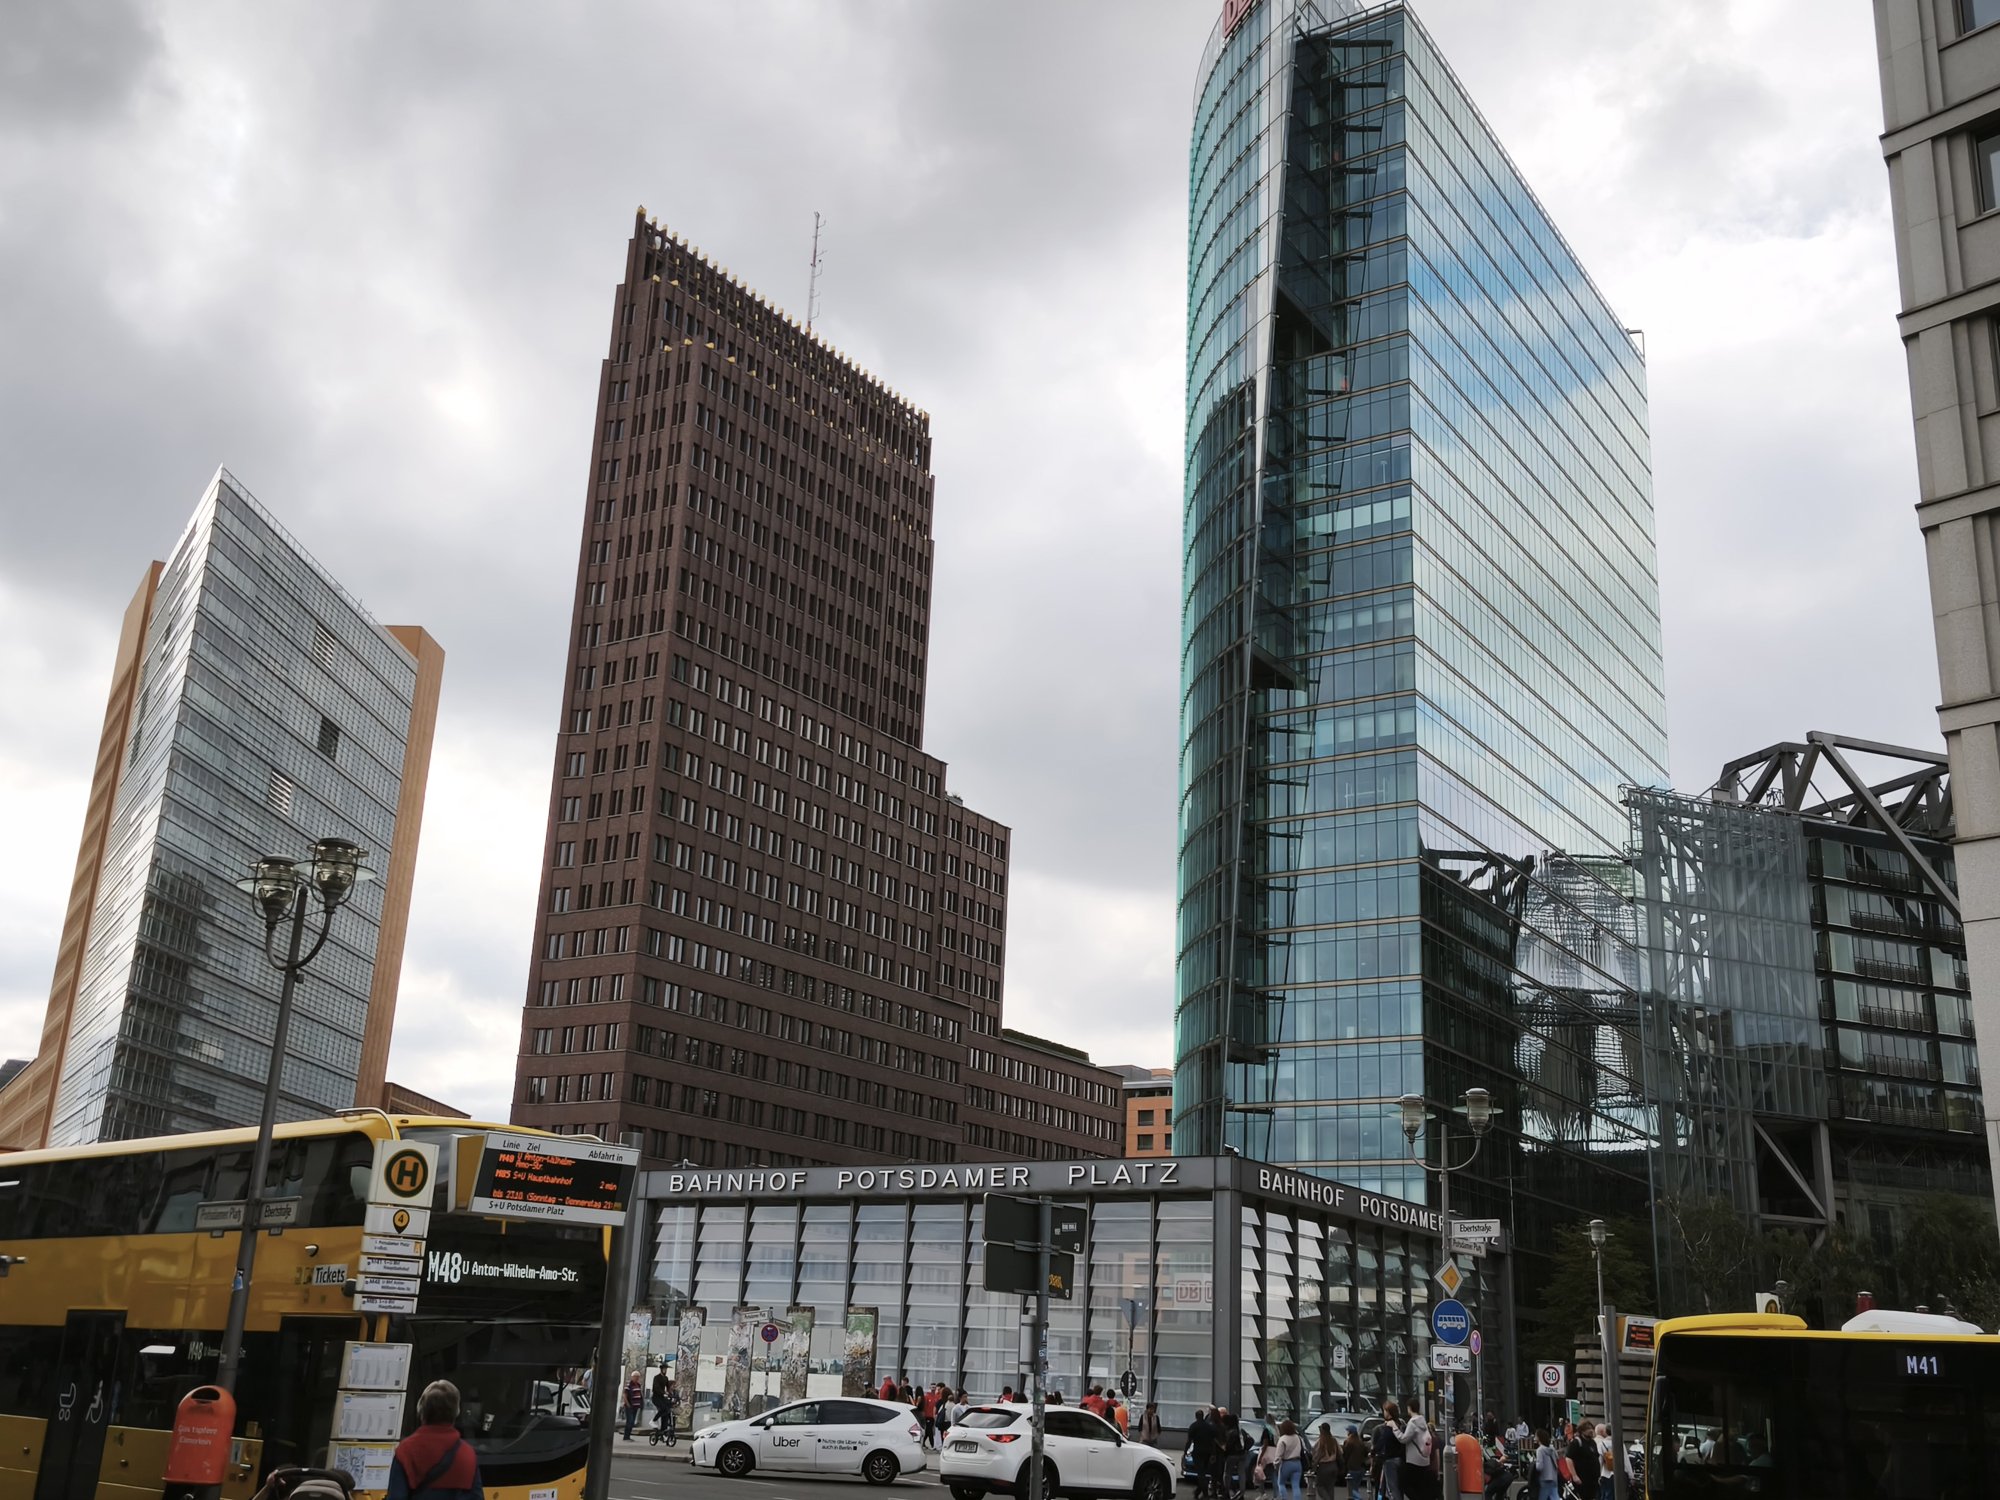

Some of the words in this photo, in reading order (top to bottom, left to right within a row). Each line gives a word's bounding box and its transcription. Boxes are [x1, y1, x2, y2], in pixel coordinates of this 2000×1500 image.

[503, 1140, 520, 1150] Linie
[527, 1142, 540, 1151] Ziel
[588, 1150, 615, 1161] Abfahrt
[616, 1154, 623, 1162] in
[397, 1160, 419, 1187] H
[527, 1173, 574, 1185] Hauptbahnhof
[669, 1171, 807, 1193] BAHNHOF
[838, 1166, 1029, 1190] POTSDAMER
[1068, 1162, 1179, 1186] PLATZ
[600, 1181, 604, 1189] 2
[605, 1183, 617, 1191] min
[1259, 1169, 1345, 1207] BAHNHOF
[488, 1201, 505, 1210] S+U
[506, 1202, 545, 1214] Potsdamer
[547, 1206, 565, 1216] Platz
[398, 1214, 404, 1223] 4
[1459, 1223, 1492, 1233] Ebertstraße
[427, 1251, 462, 1283] M48
[462, 1260, 470, 1275] U
[471, 1261, 579, 1282] Anton-Wilhelm-Amo-Str.
[315, 1266, 345, 1284] Tickets
[188, 1341, 204, 1360] M48
[1441, 1353, 1463, 1364] nde
[1906, 1355, 1938, 1375] M41
[1546, 1371, 1557, 1381] 30
[772, 1436, 801, 1447] Uber
